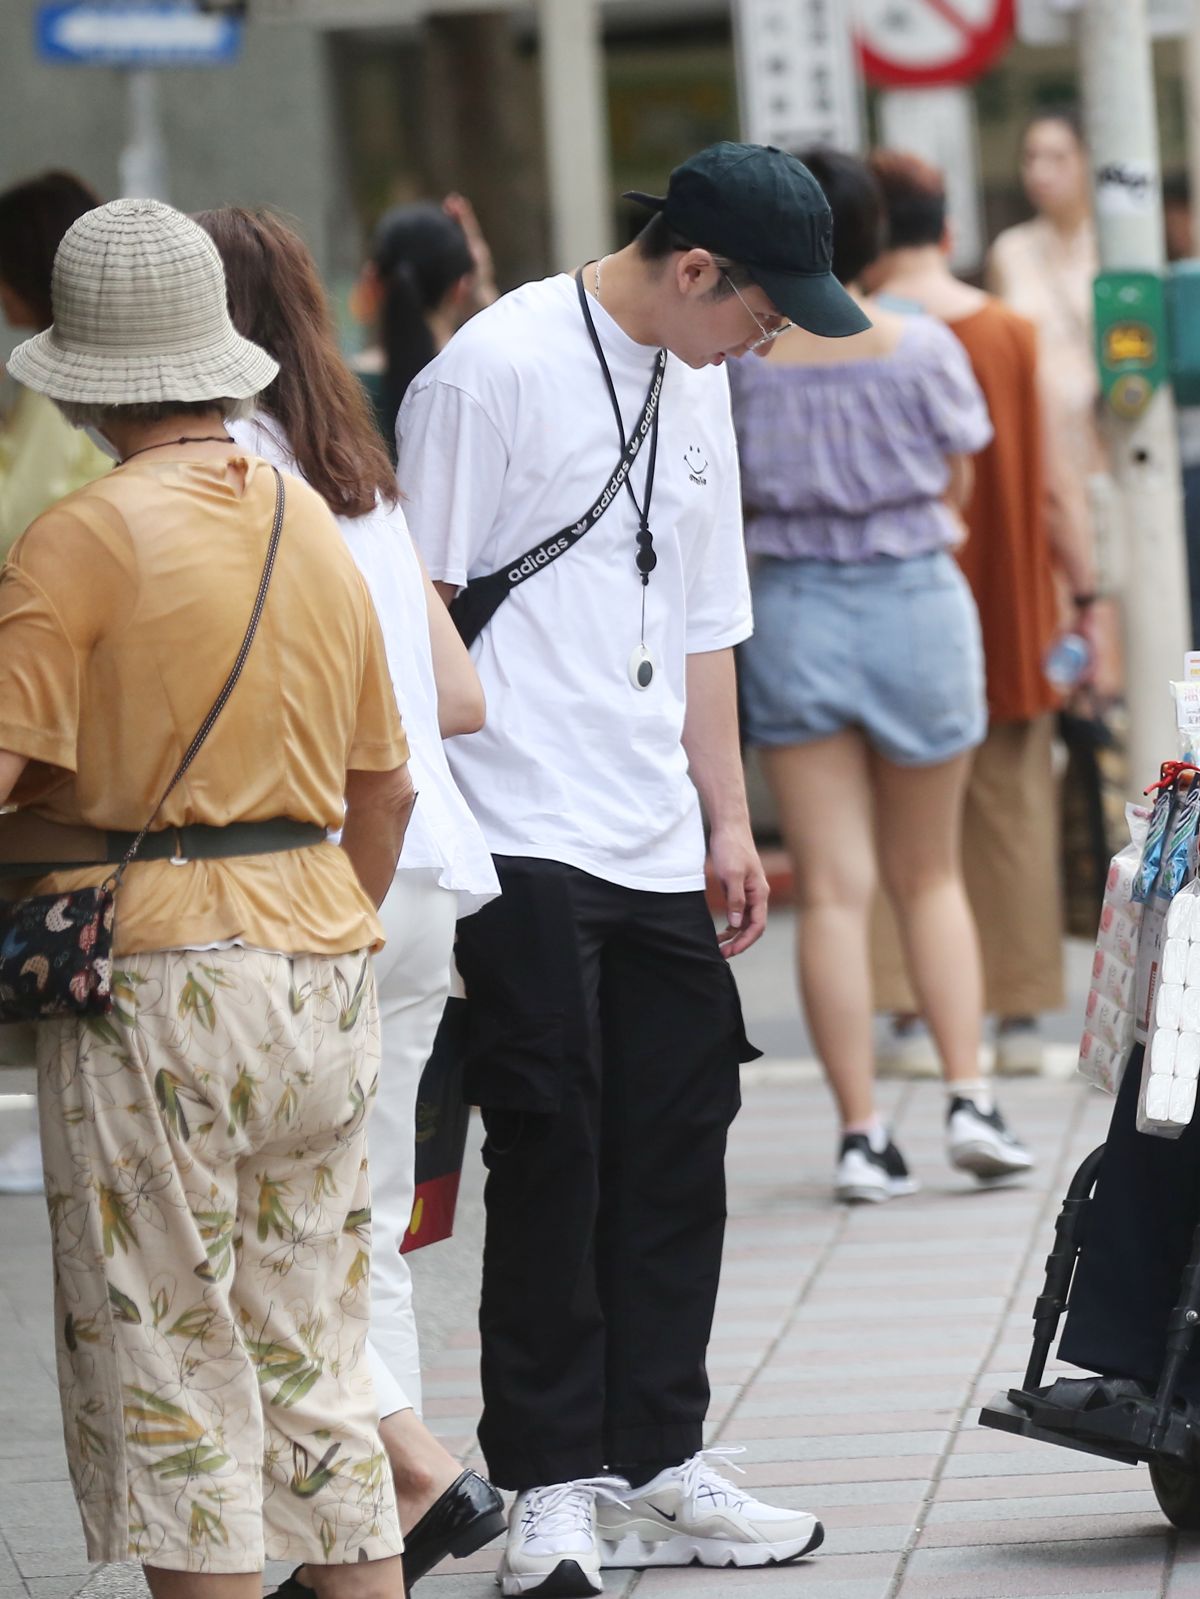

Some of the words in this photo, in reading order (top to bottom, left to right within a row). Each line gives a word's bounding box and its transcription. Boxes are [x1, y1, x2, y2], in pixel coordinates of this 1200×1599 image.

[640, 374, 662, 434] adidas
[592, 459, 629, 519] adidas
[507, 537, 569, 582] adidas
